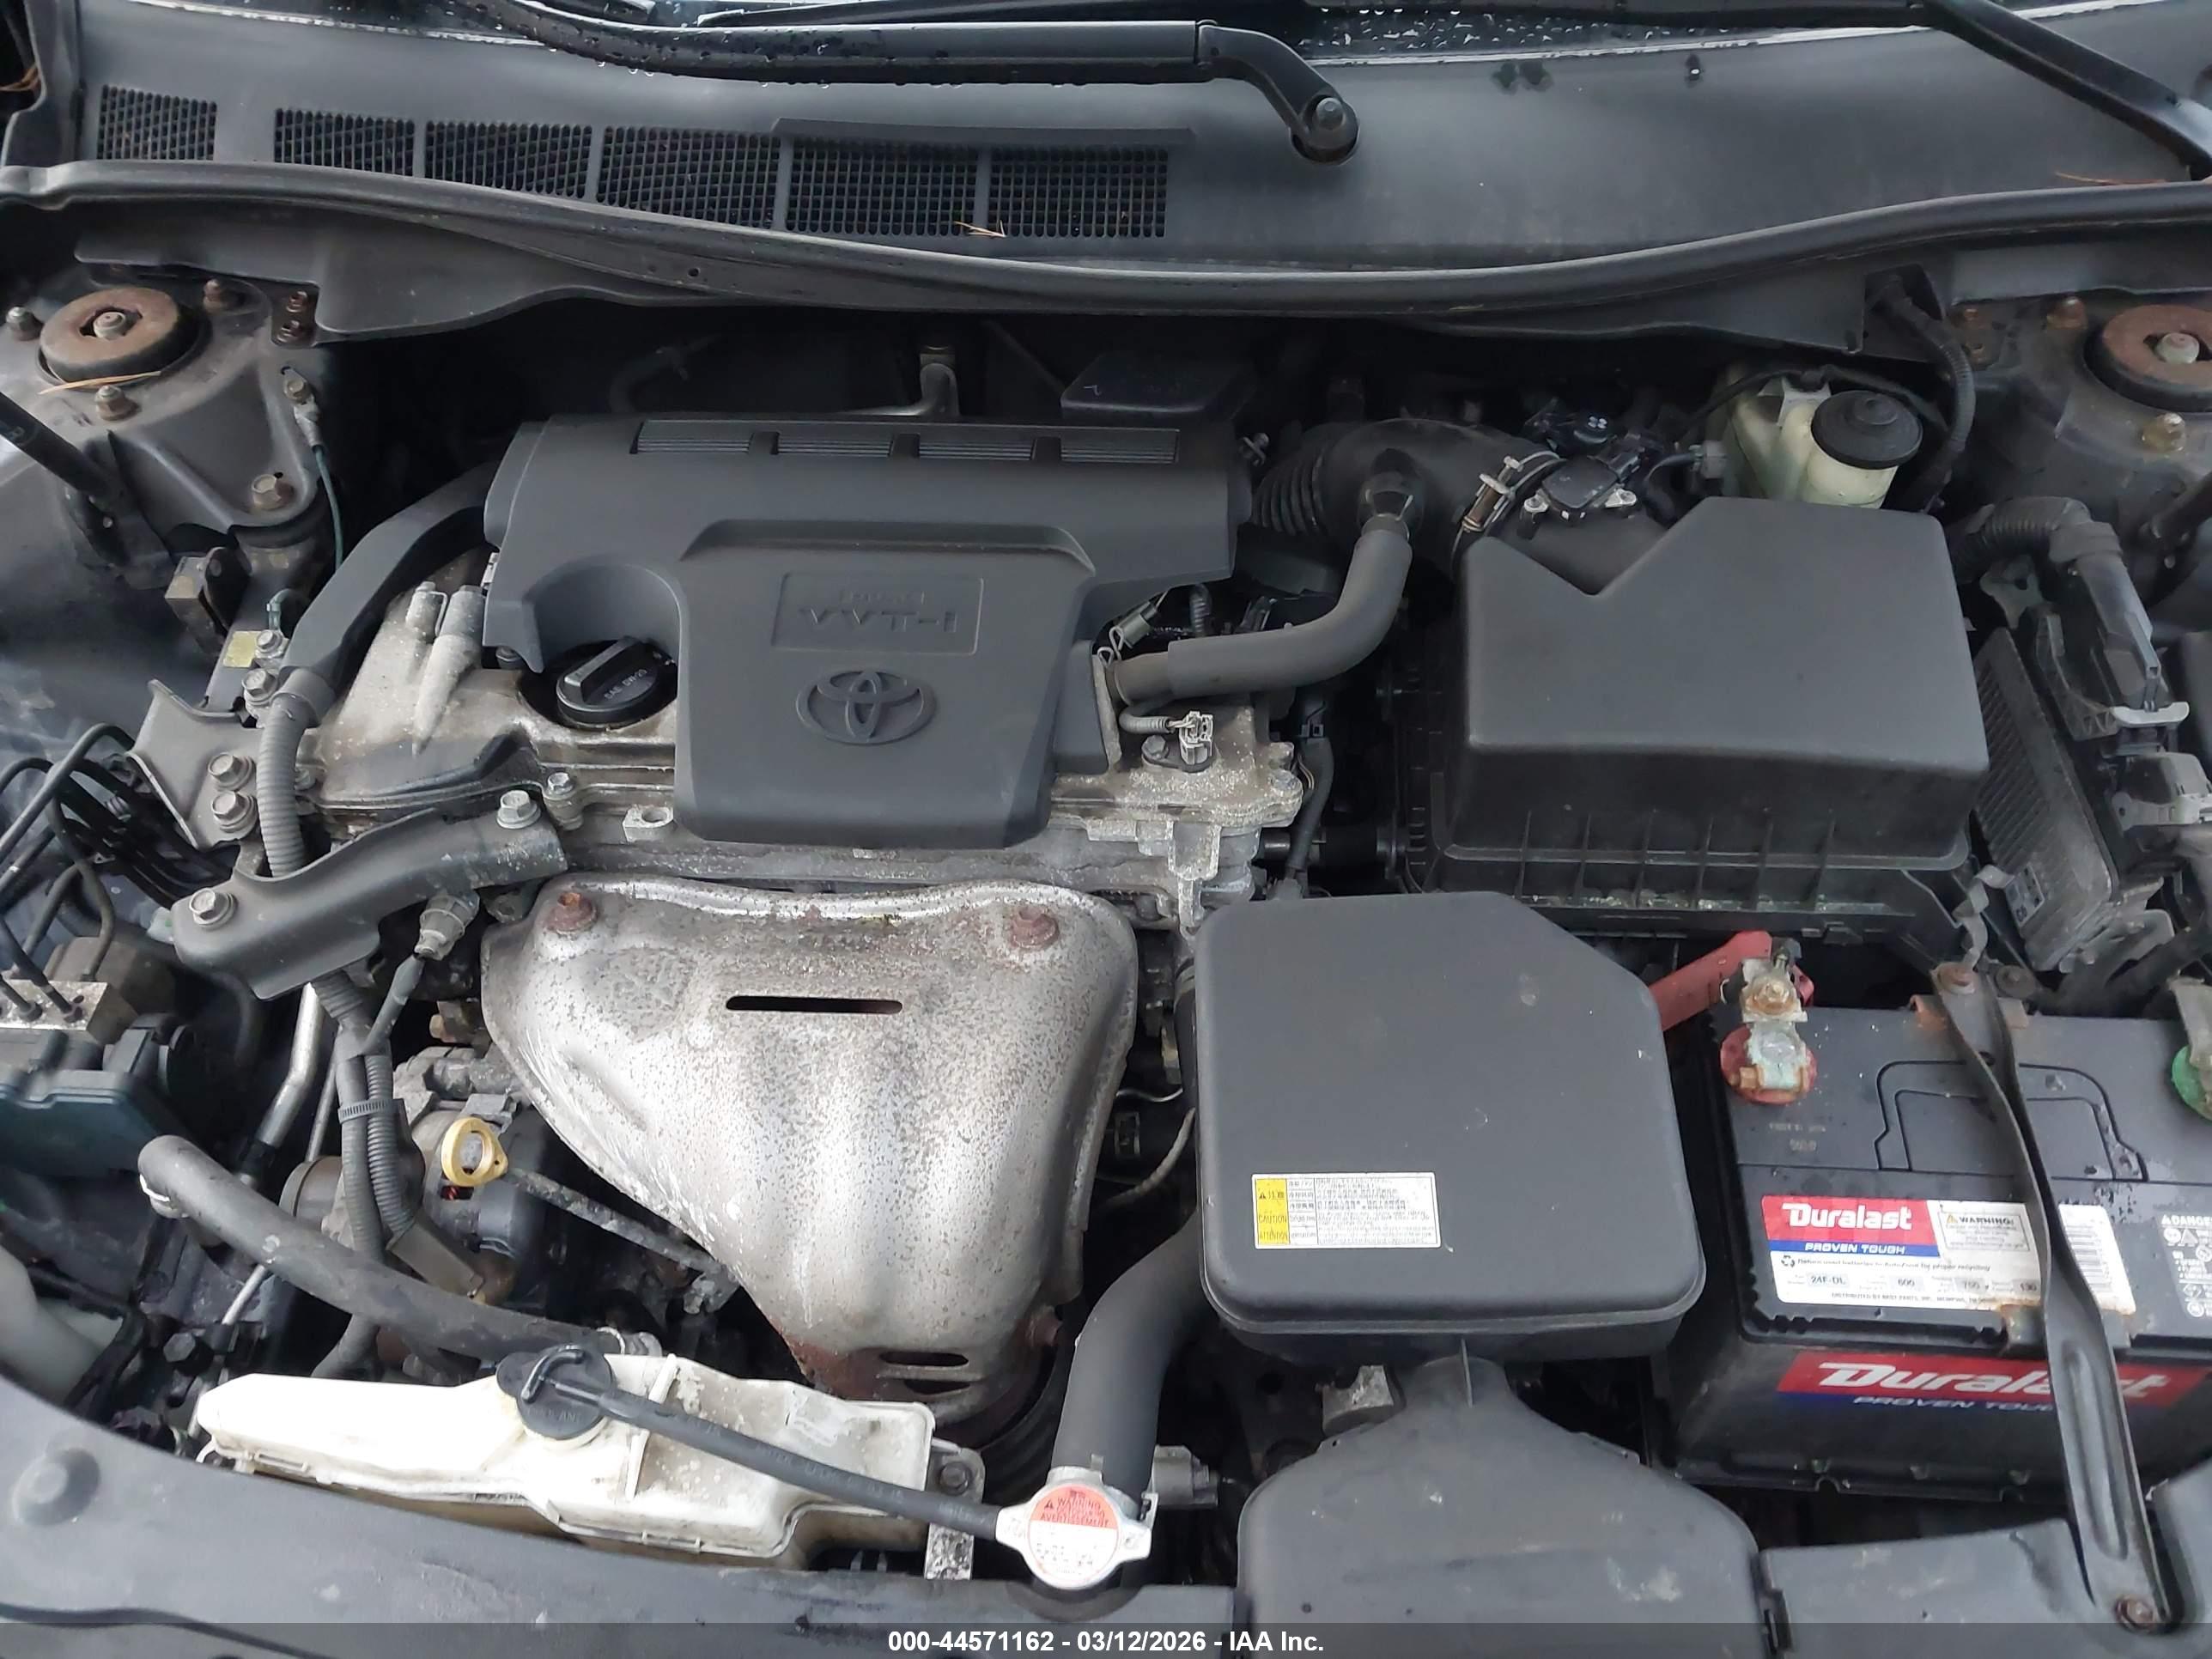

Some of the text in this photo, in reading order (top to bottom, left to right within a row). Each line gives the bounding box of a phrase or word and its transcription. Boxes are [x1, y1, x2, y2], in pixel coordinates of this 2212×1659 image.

[1258, 1215, 1287, 1224] CAUTION
[1782, 1201, 1913, 1231] Duralast
[2171, 1214, 2212, 1227] DANGE
[1804, 1243, 1905, 1255] PROVEN TOUGH
[1851, 1395, 1975, 1409] PROVEN
